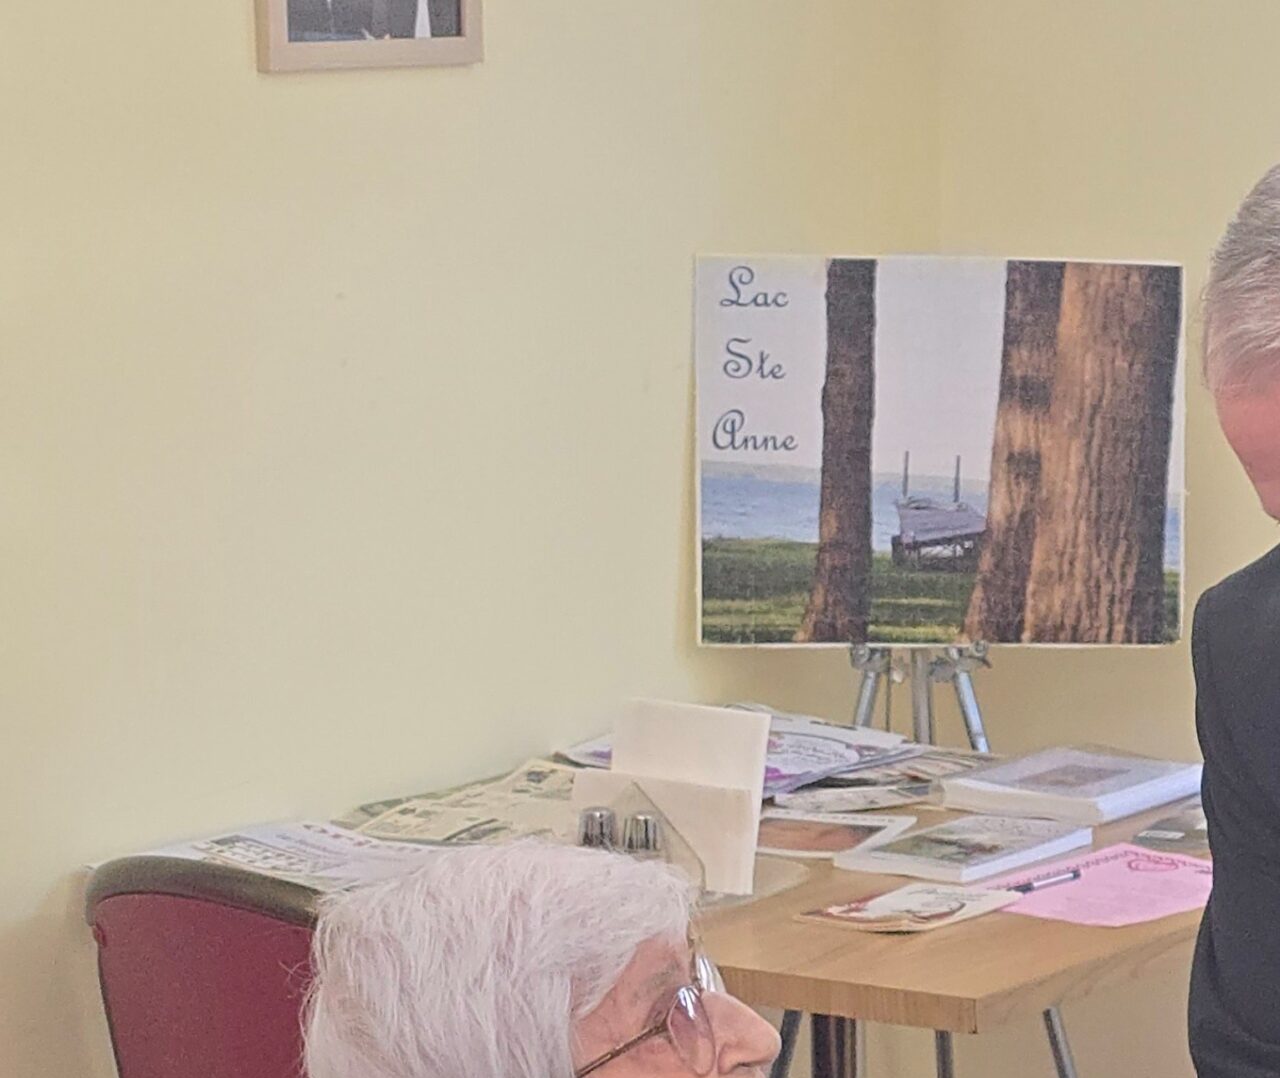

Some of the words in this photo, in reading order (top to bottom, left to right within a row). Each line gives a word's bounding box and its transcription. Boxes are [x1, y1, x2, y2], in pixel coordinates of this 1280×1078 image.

[719, 266, 789, 308] Lac
[722, 338, 786, 380] Ste
[712, 409, 798, 451] Anne
